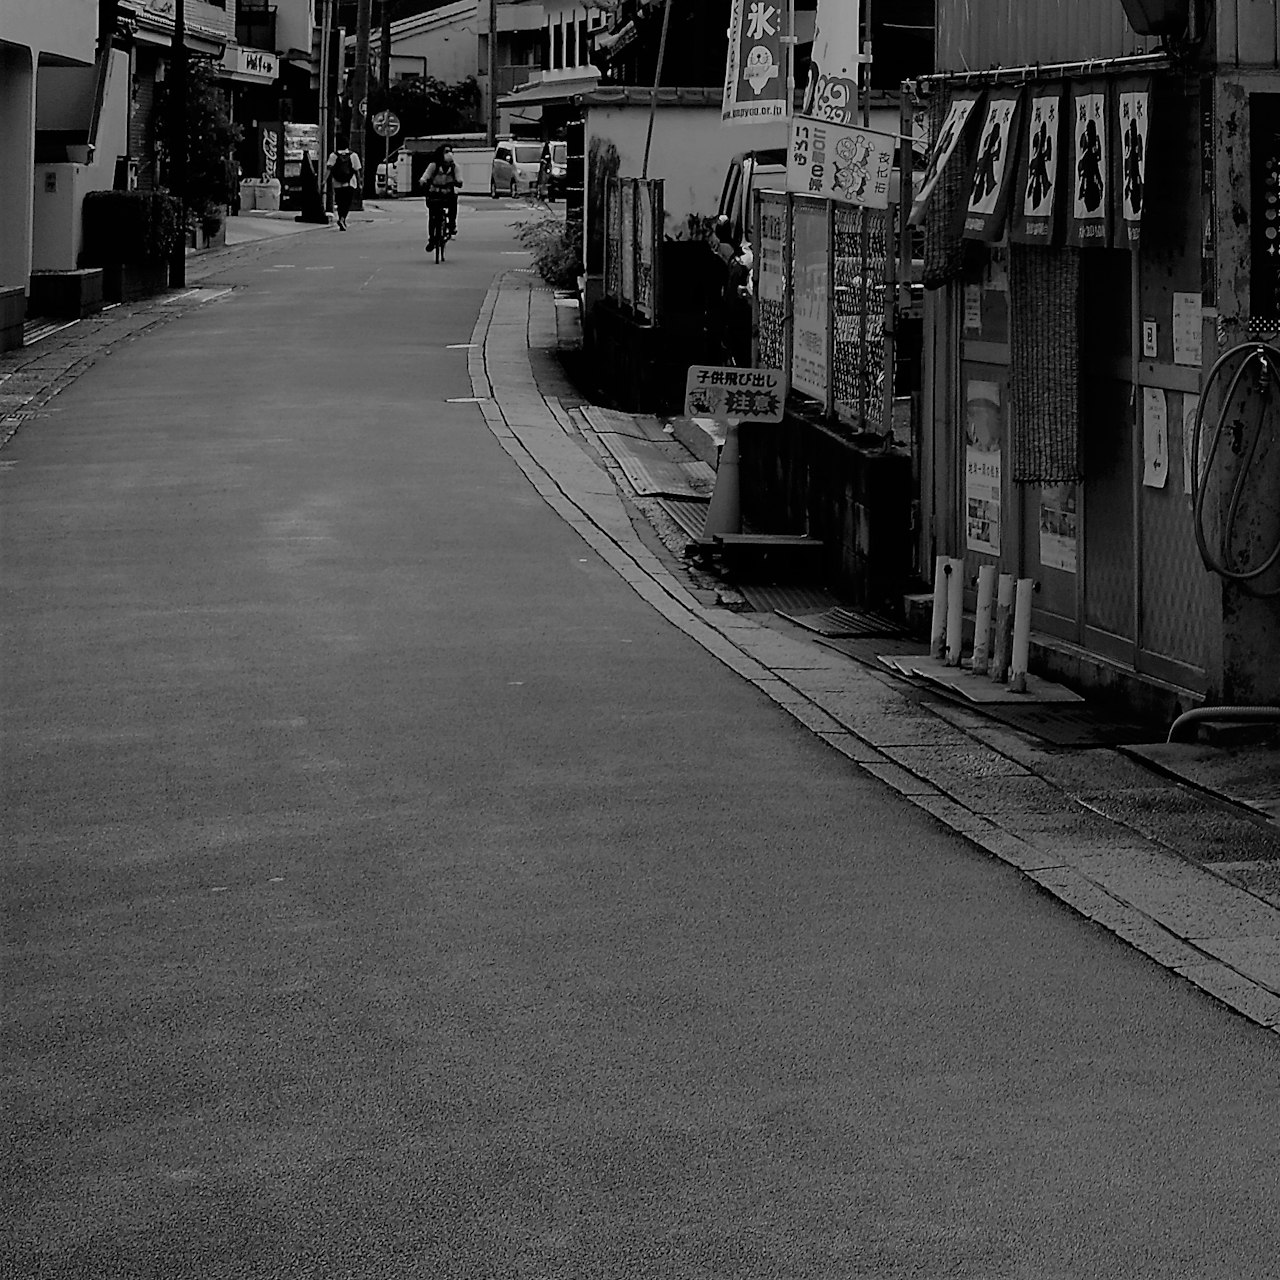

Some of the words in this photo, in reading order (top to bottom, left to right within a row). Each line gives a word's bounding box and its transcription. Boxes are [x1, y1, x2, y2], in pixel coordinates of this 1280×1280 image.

[697, 371, 777, 388] 子供飛び出し
[732, 392, 770, 412] 注意
